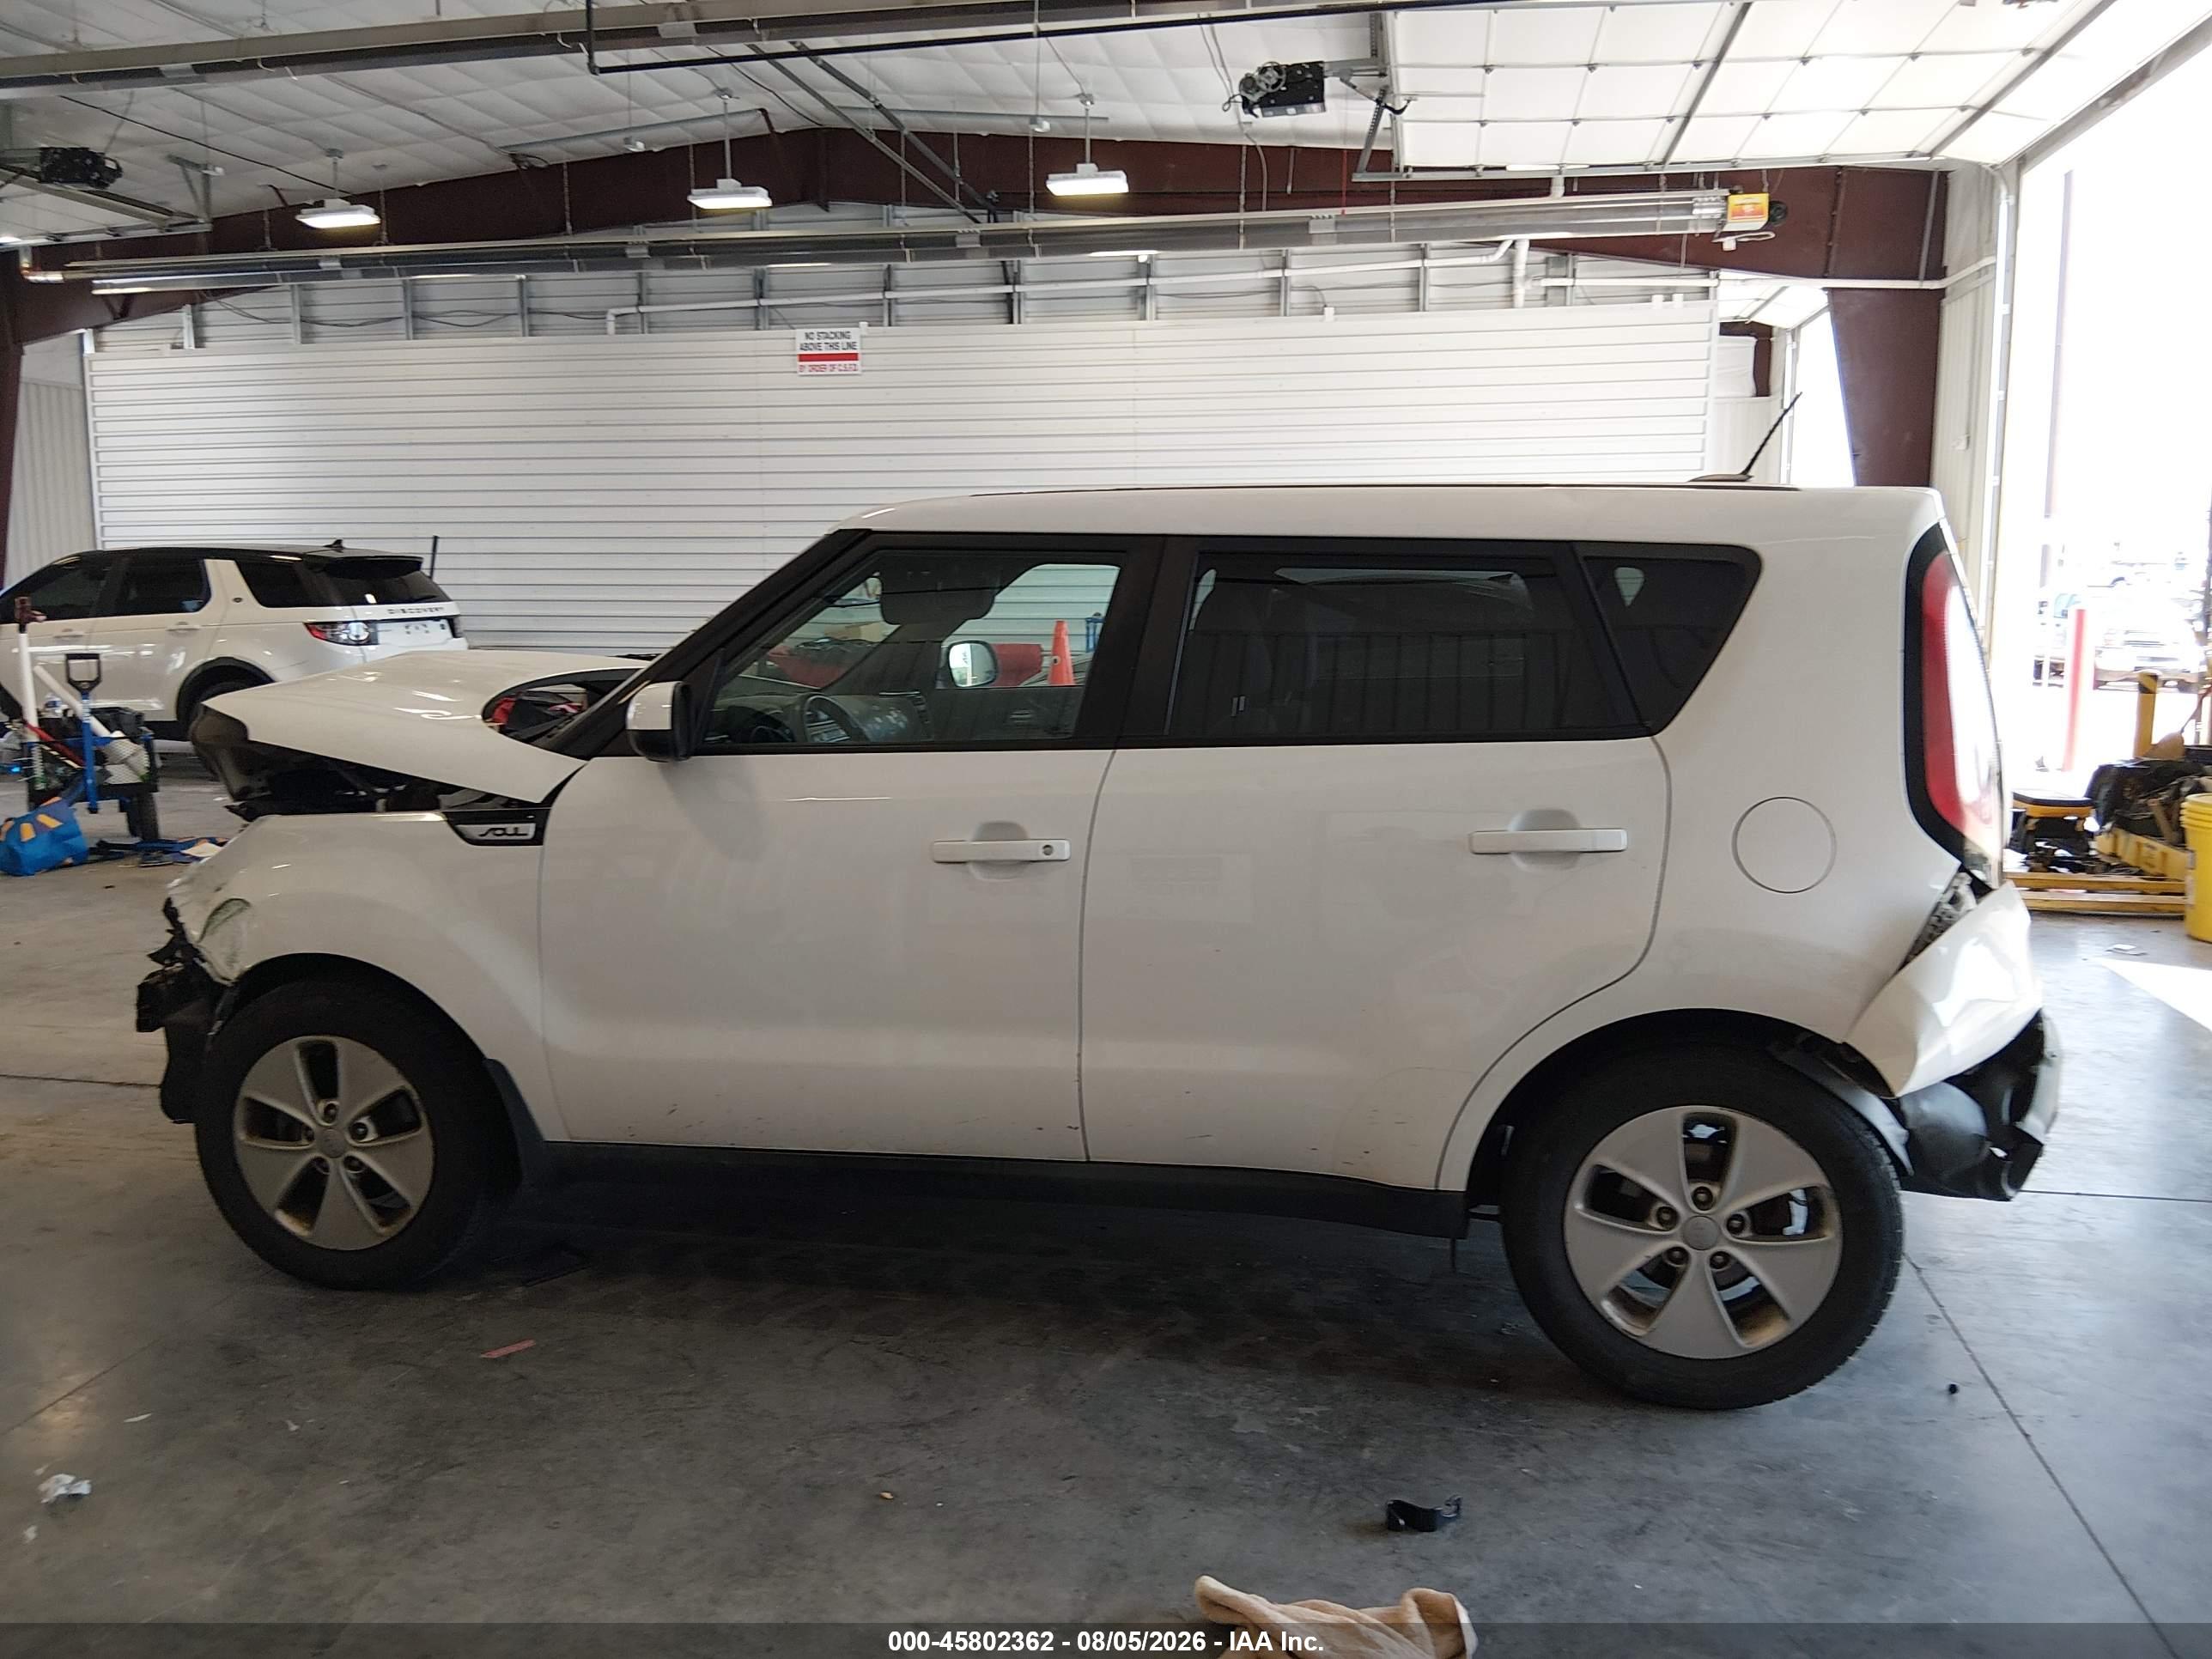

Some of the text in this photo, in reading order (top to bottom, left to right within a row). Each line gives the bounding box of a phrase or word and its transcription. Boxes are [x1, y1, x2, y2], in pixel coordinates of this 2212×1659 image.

[805, 331, 851, 340] NO STACKING
[799, 341, 858, 351] ABOVE THIS LINE
